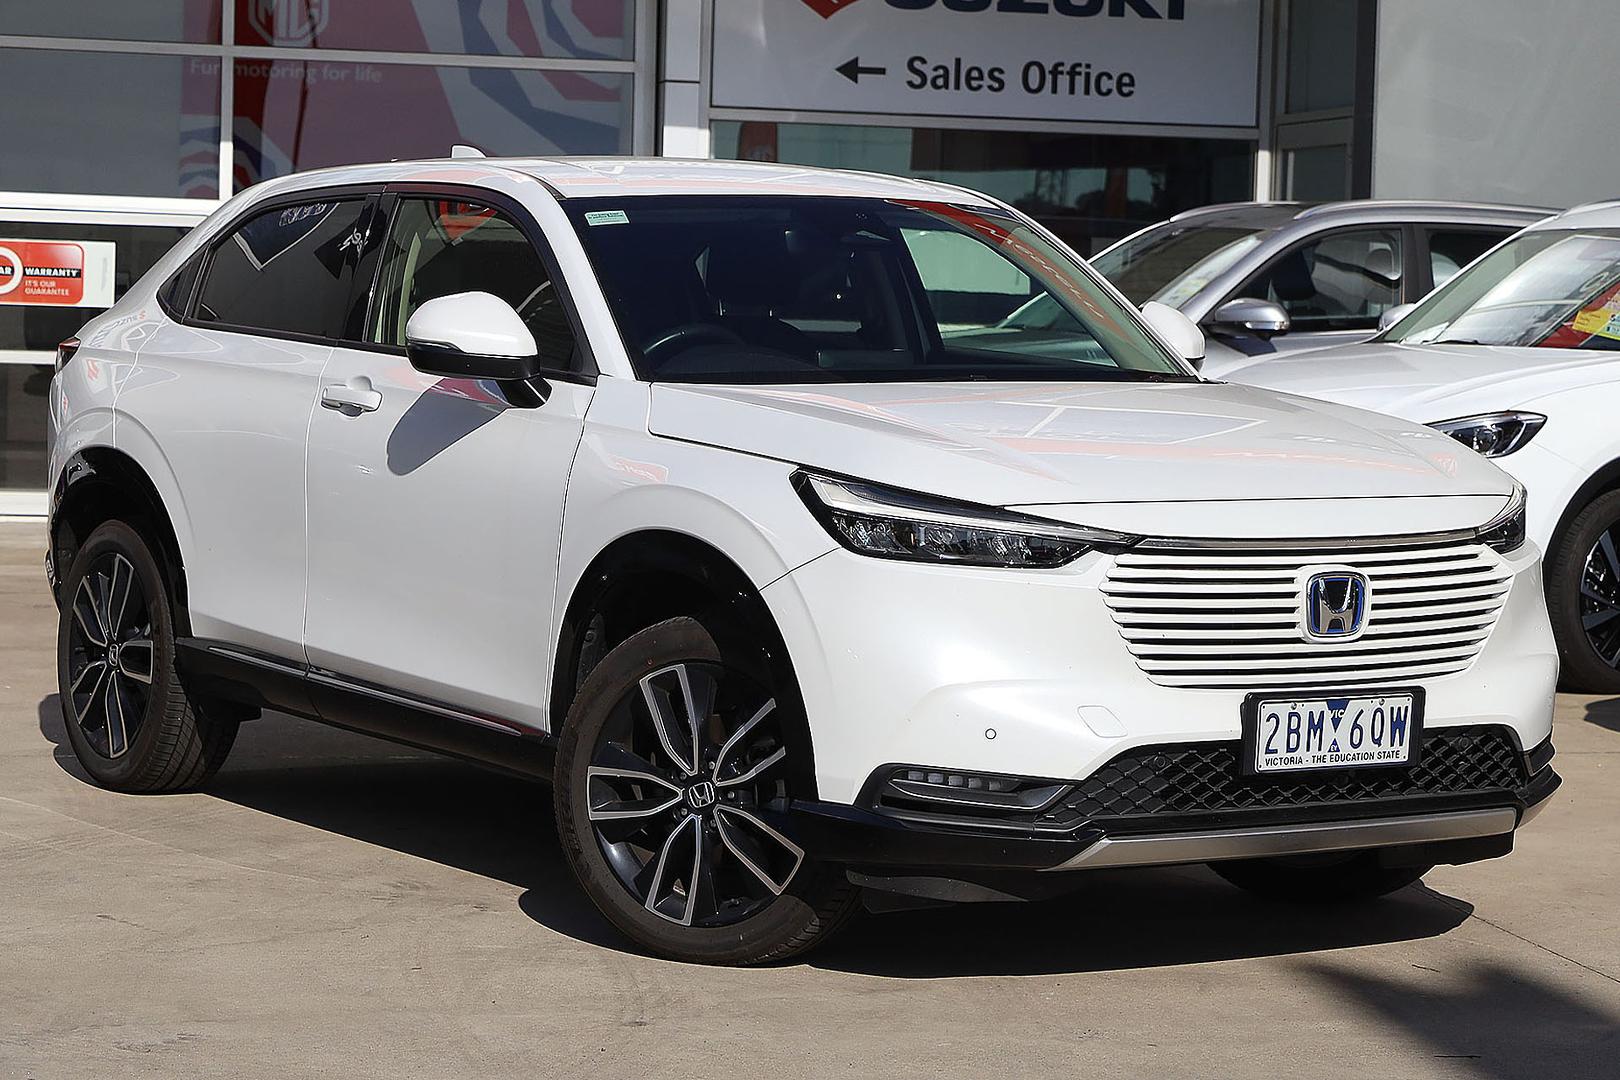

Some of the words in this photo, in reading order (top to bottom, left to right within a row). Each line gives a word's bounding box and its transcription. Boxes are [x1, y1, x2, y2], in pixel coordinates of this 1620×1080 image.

[322, 65, 348, 80] for
[355, 65, 383, 82] life
[905, 55, 1005, 93] Sales
[1021, 60, 1136, 97] Office
[25, 267, 78, 277] WARRANTY
[39, 280, 56, 288] OUR
[24, 288, 69, 296] GUARANTEE
[1330, 709, 1345, 719] VIC
[1264, 711, 1325, 754] 2BM
[1350, 706, 1408, 749] 6QW
[1265, 756, 1303, 767] VICTORIA
[1311, 754, 1327, 764] THE
[1329, 751, 1375, 763] EDUCATION
[1376, 750, 1400, 760] STATE
